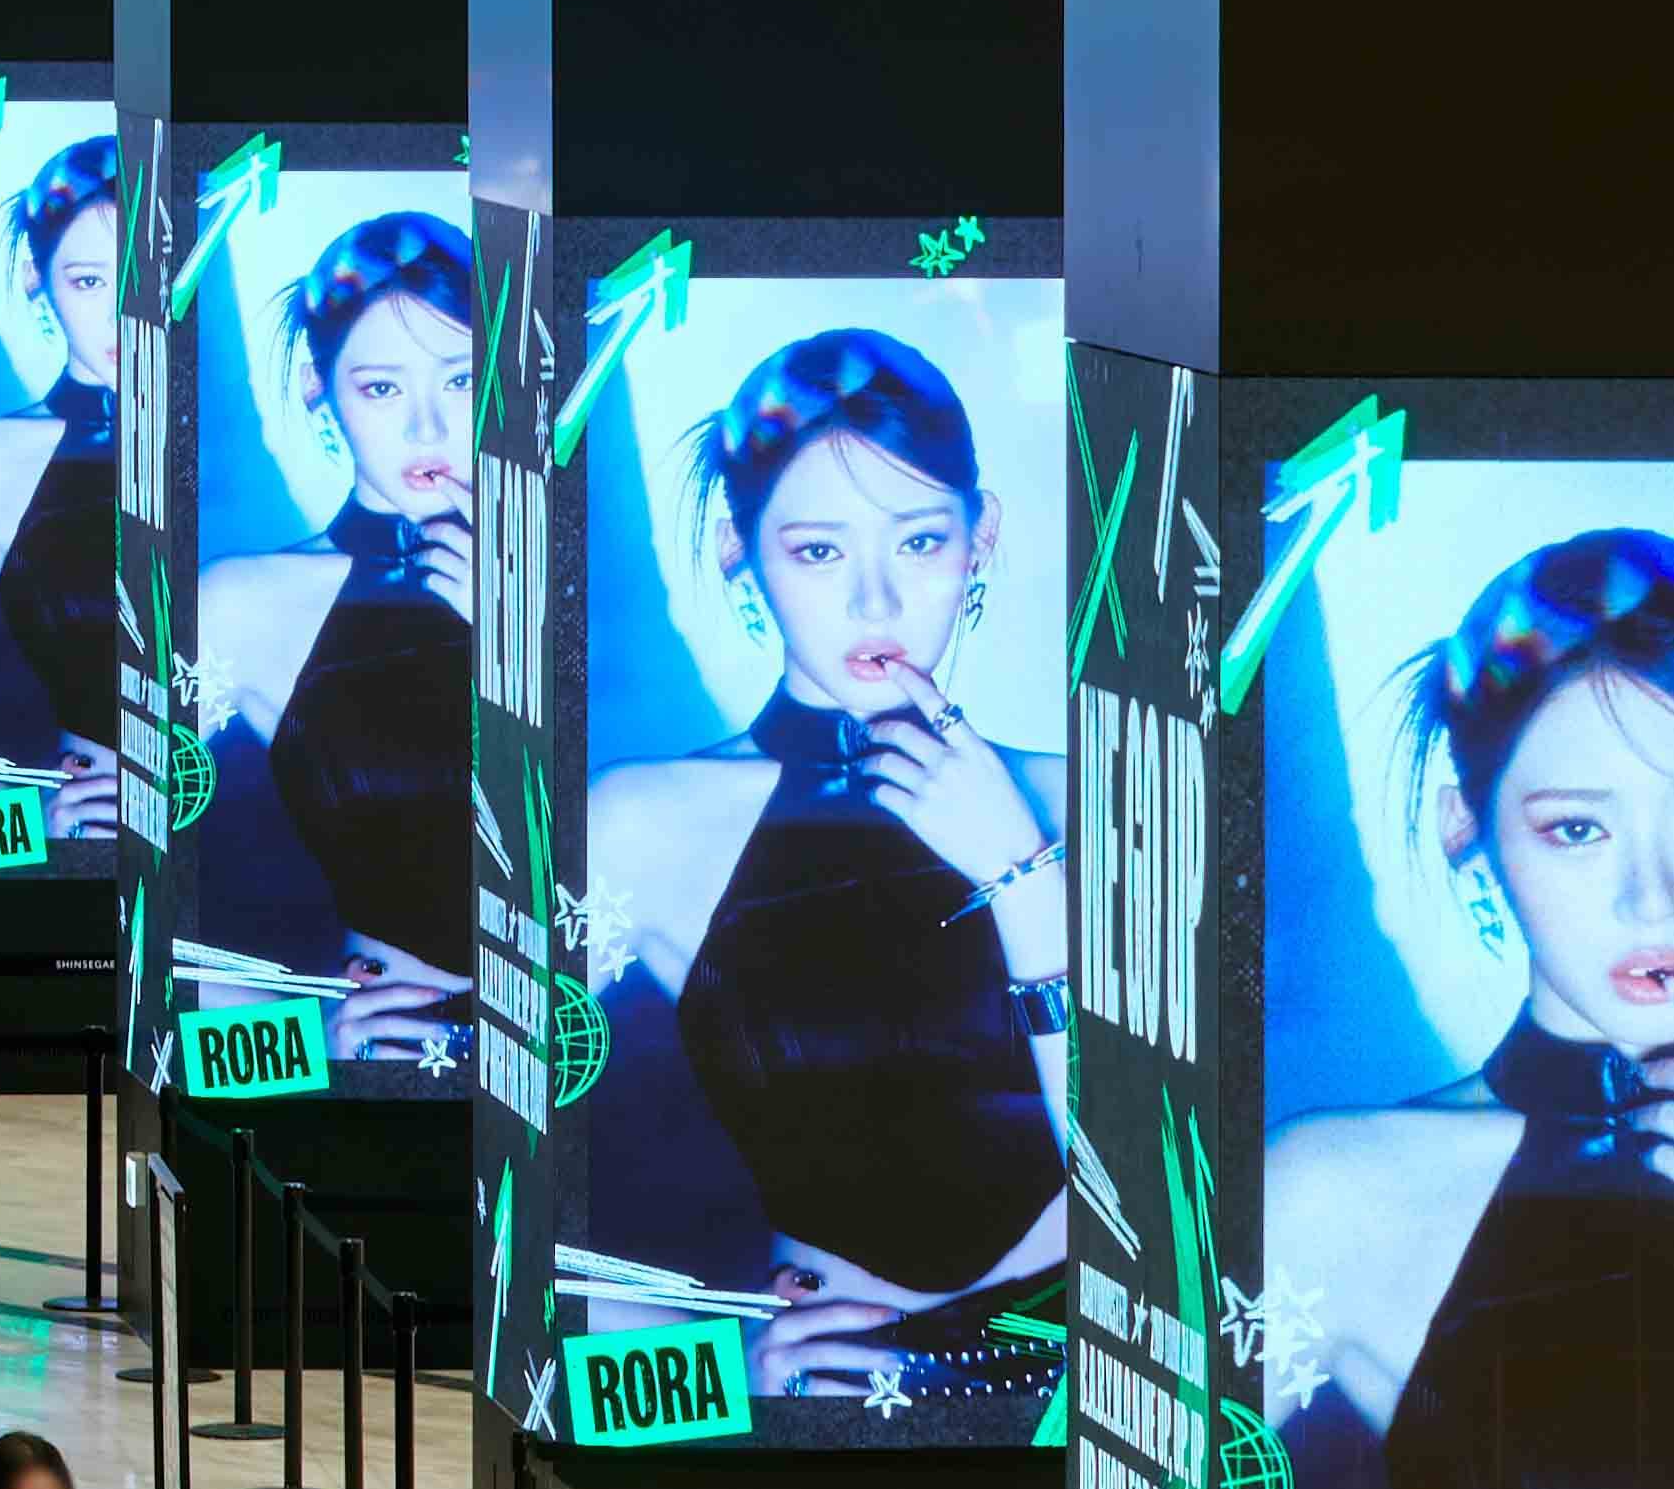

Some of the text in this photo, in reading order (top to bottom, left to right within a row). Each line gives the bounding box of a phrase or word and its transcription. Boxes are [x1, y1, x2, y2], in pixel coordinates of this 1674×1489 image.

[1080, 681, 1207, 1065] WE GO UP
[55, 959, 116, 970] SHINSEGAE
[197, 1014, 312, 1090] RORA
[586, 1342, 730, 1434] RORA
